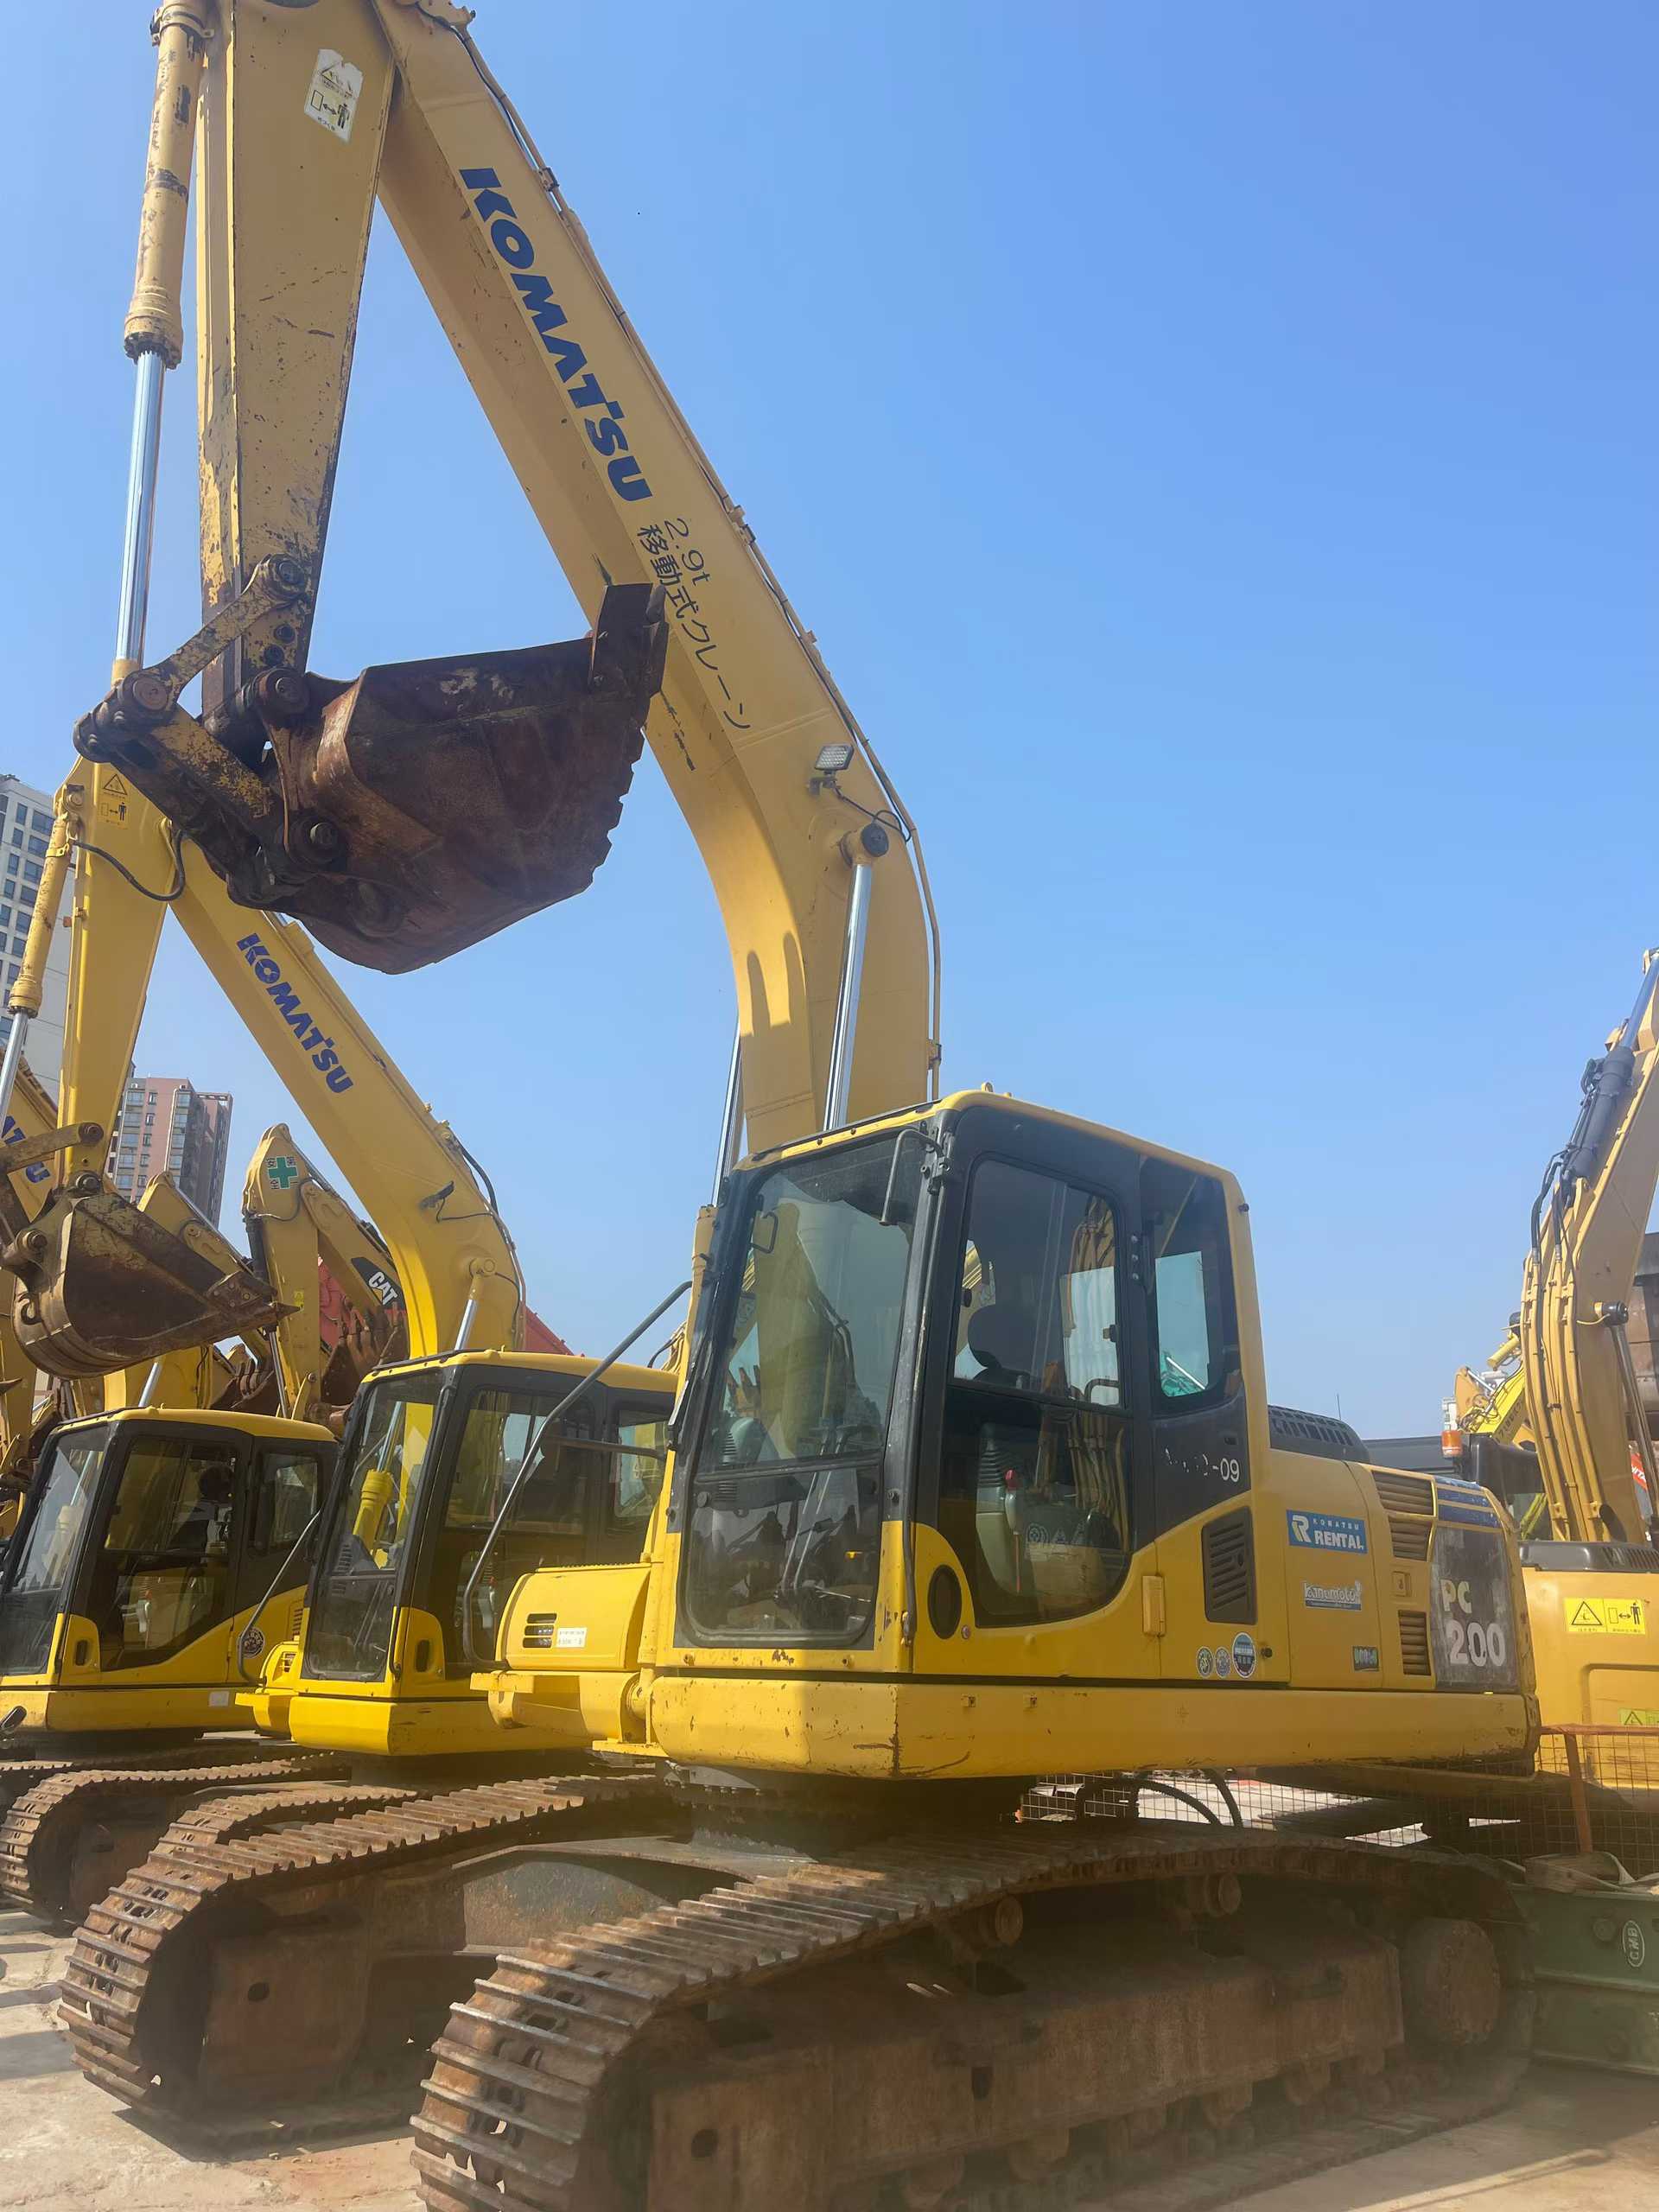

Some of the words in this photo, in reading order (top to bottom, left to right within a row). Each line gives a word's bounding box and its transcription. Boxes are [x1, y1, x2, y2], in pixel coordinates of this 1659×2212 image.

[458, 167, 653, 502] KOMATSU
[664, 517, 710, 587] 2.9t
[636, 524, 752, 729] 移動式クレーン
[236, 932, 354, 1094] KOMATSU
[368, 1271, 398, 1306] CAT
[1313, 1517, 1359, 1530] KOMATSU
[1313, 1529, 1363, 1550] RENTAL
[1440, 1579, 1472, 1614] PC
[1446, 1618, 1505, 1667] 200
